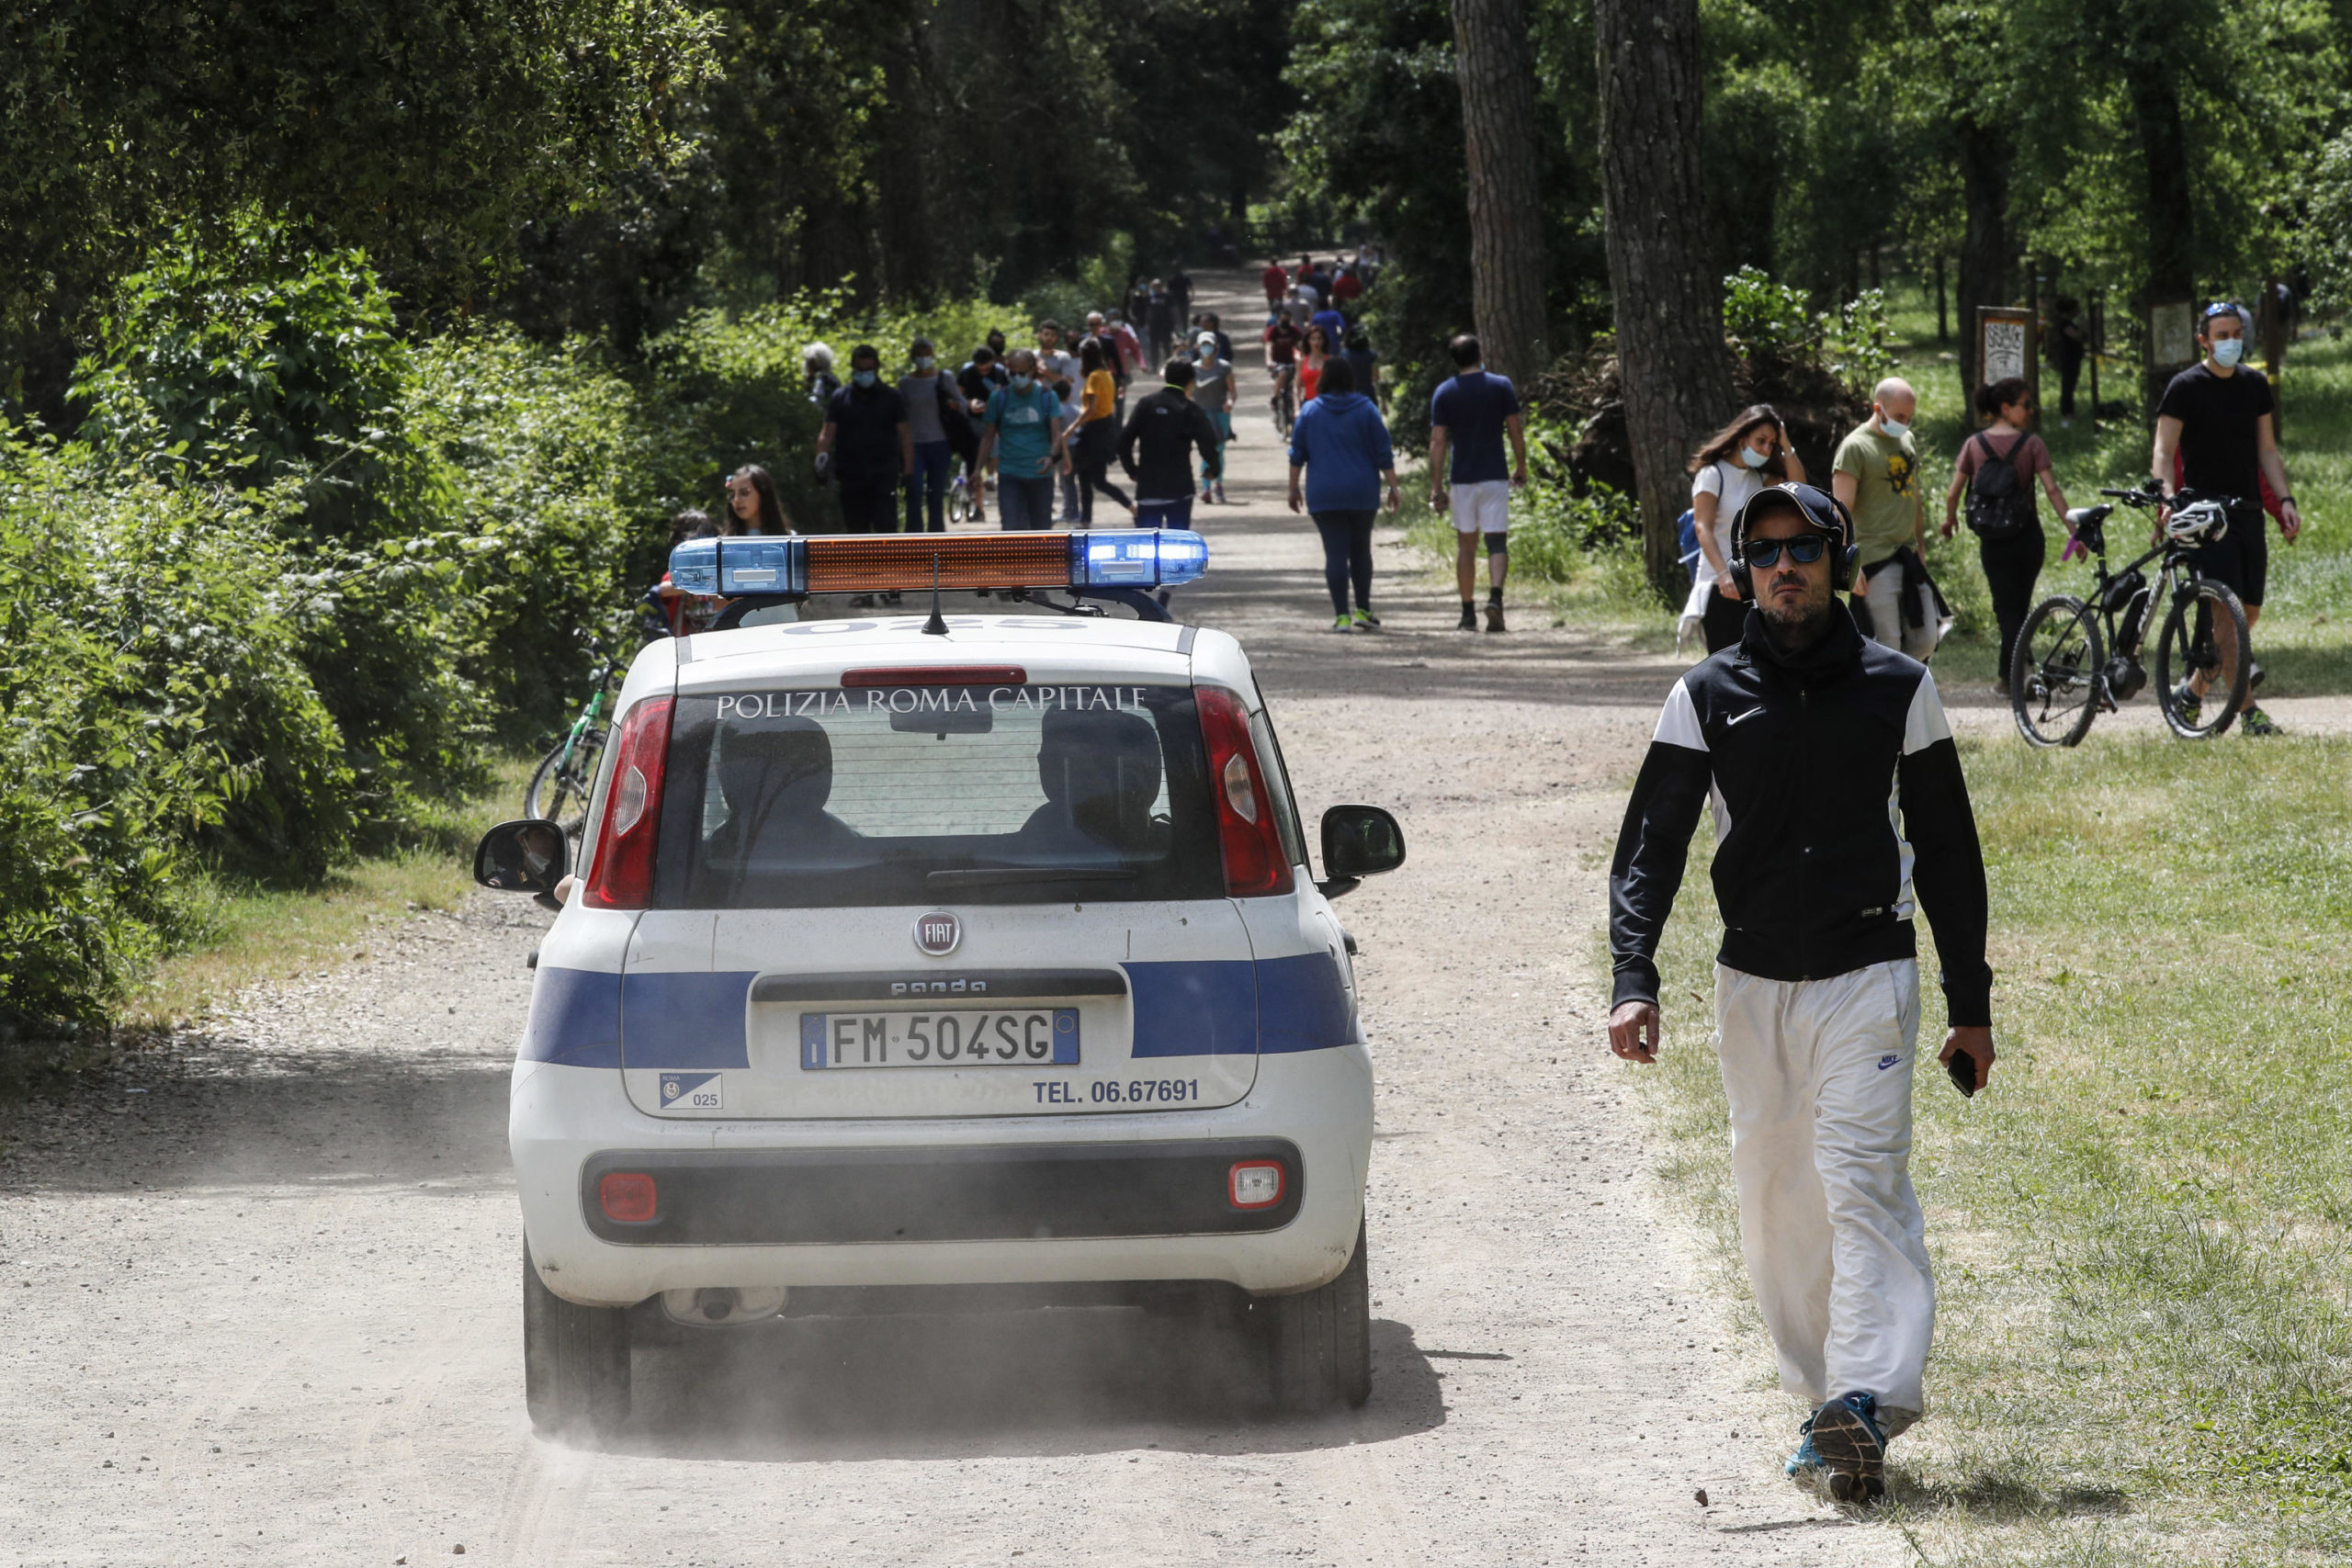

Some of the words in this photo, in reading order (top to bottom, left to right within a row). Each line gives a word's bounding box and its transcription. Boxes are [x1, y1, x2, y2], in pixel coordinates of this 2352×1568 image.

[782, 617, 1089, 636] 025
[716, 690, 854, 720] POLIZIA
[866, 688, 978, 714] ROMA
[988, 686, 1149, 712] CAPITALE
[924, 923, 953, 943] FIAT
[891, 978, 987, 996] panda
[833, 1017, 887, 1064] FM
[907, 1014, 1048, 1061] 504SG
[1881, 1054, 1898, 1064] NIKE
[693, 1094, 718, 1106] 025
[1033, 1081, 1083, 1103] TEL.
[1091, 1078, 1198, 1103] 06.67691
